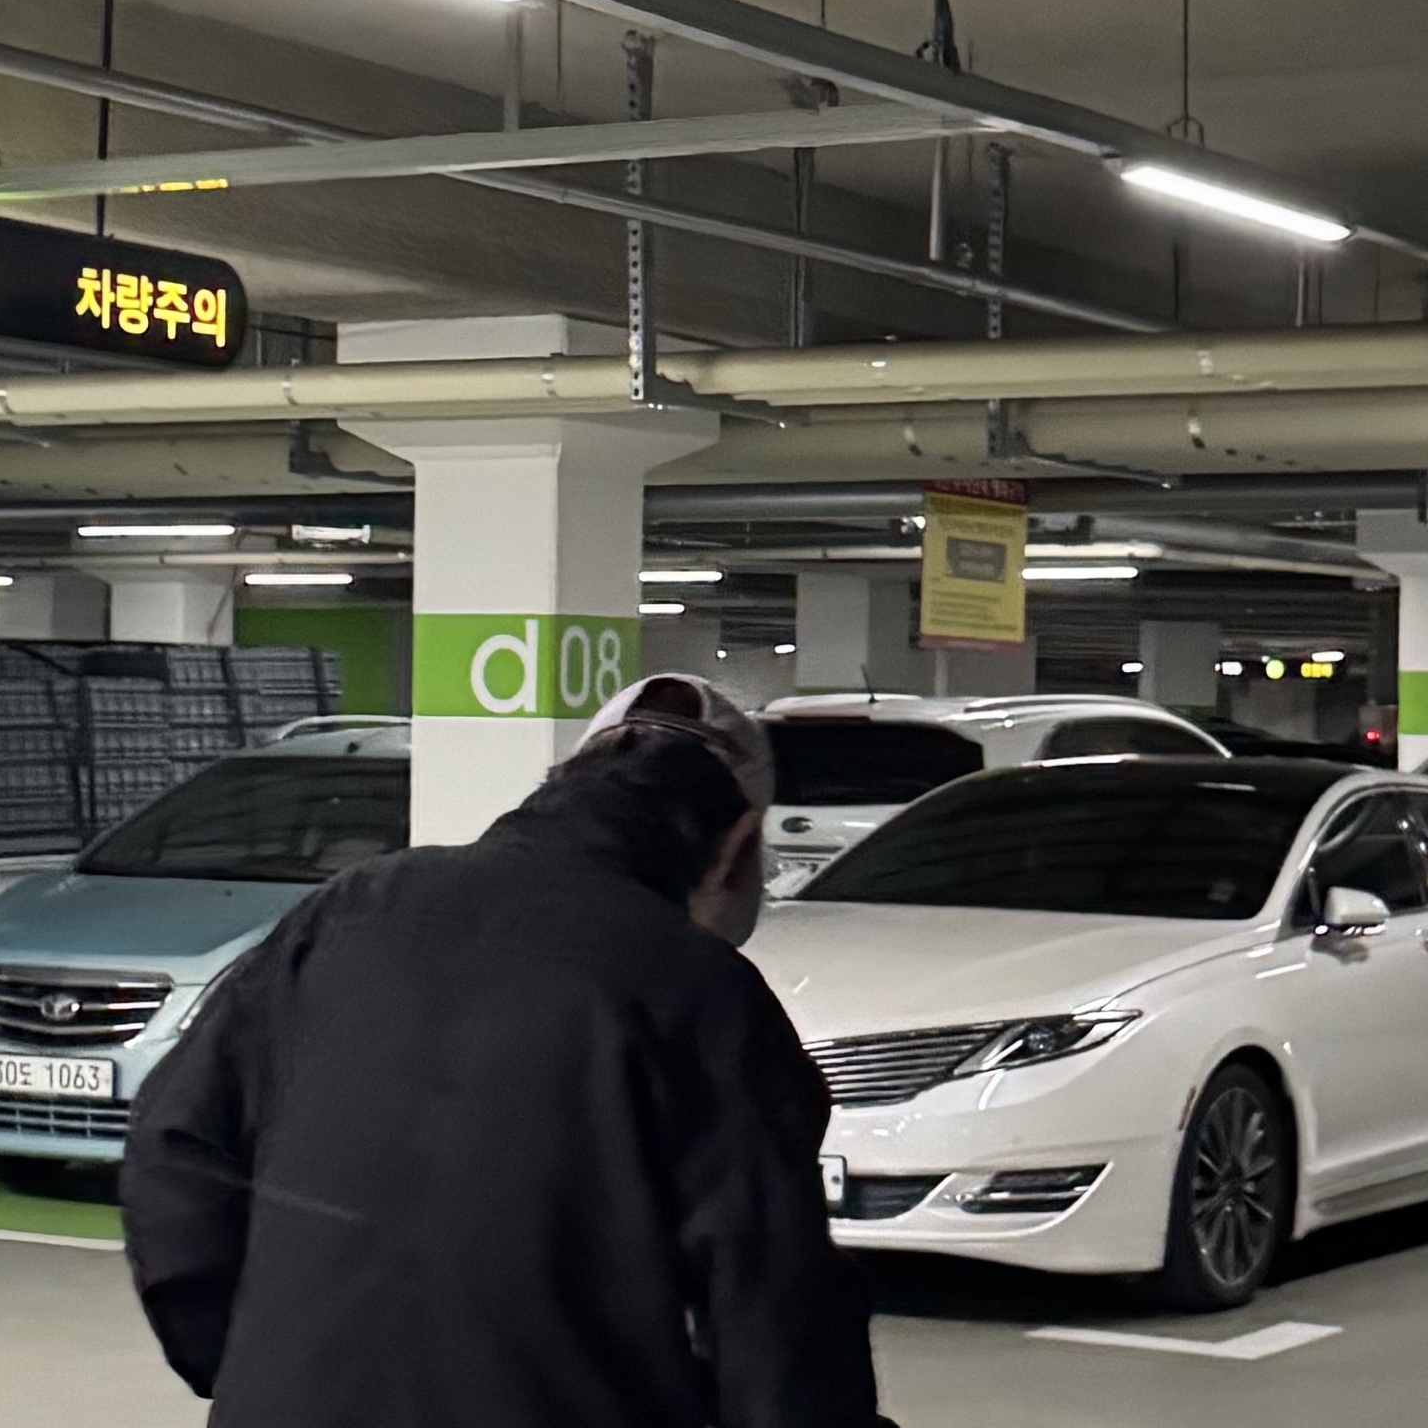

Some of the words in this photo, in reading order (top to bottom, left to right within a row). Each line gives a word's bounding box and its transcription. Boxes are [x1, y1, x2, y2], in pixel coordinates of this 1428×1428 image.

[75, 267, 227, 348] 차량주의
[470, 619, 539, 714] d
[560, 625, 622, 708] 08
[44, 1062, 100, 1091] 1063
